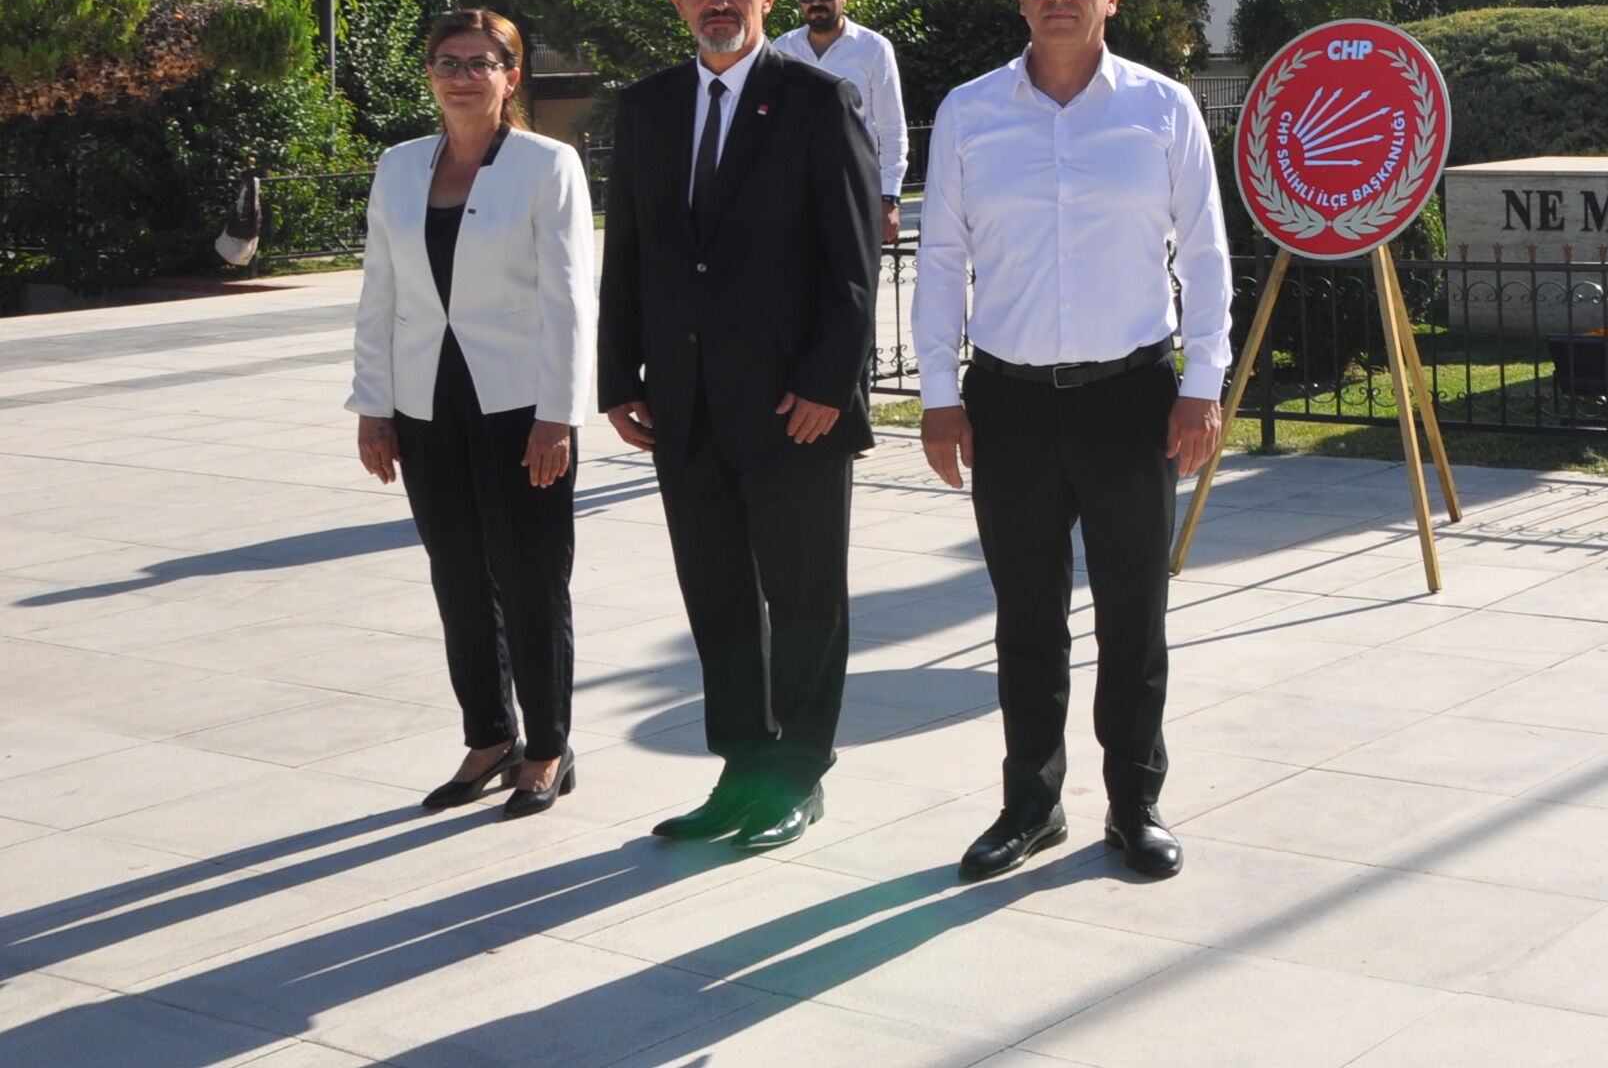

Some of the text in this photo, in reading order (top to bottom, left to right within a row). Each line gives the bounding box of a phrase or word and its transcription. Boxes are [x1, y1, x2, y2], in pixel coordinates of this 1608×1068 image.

[1327, 39, 1373, 61] CHP
[1276, 109, 1407, 211] CHP SALİHLİ İLÇE BAŞKANLIĞI
[1502, 189, 1565, 232] NE
